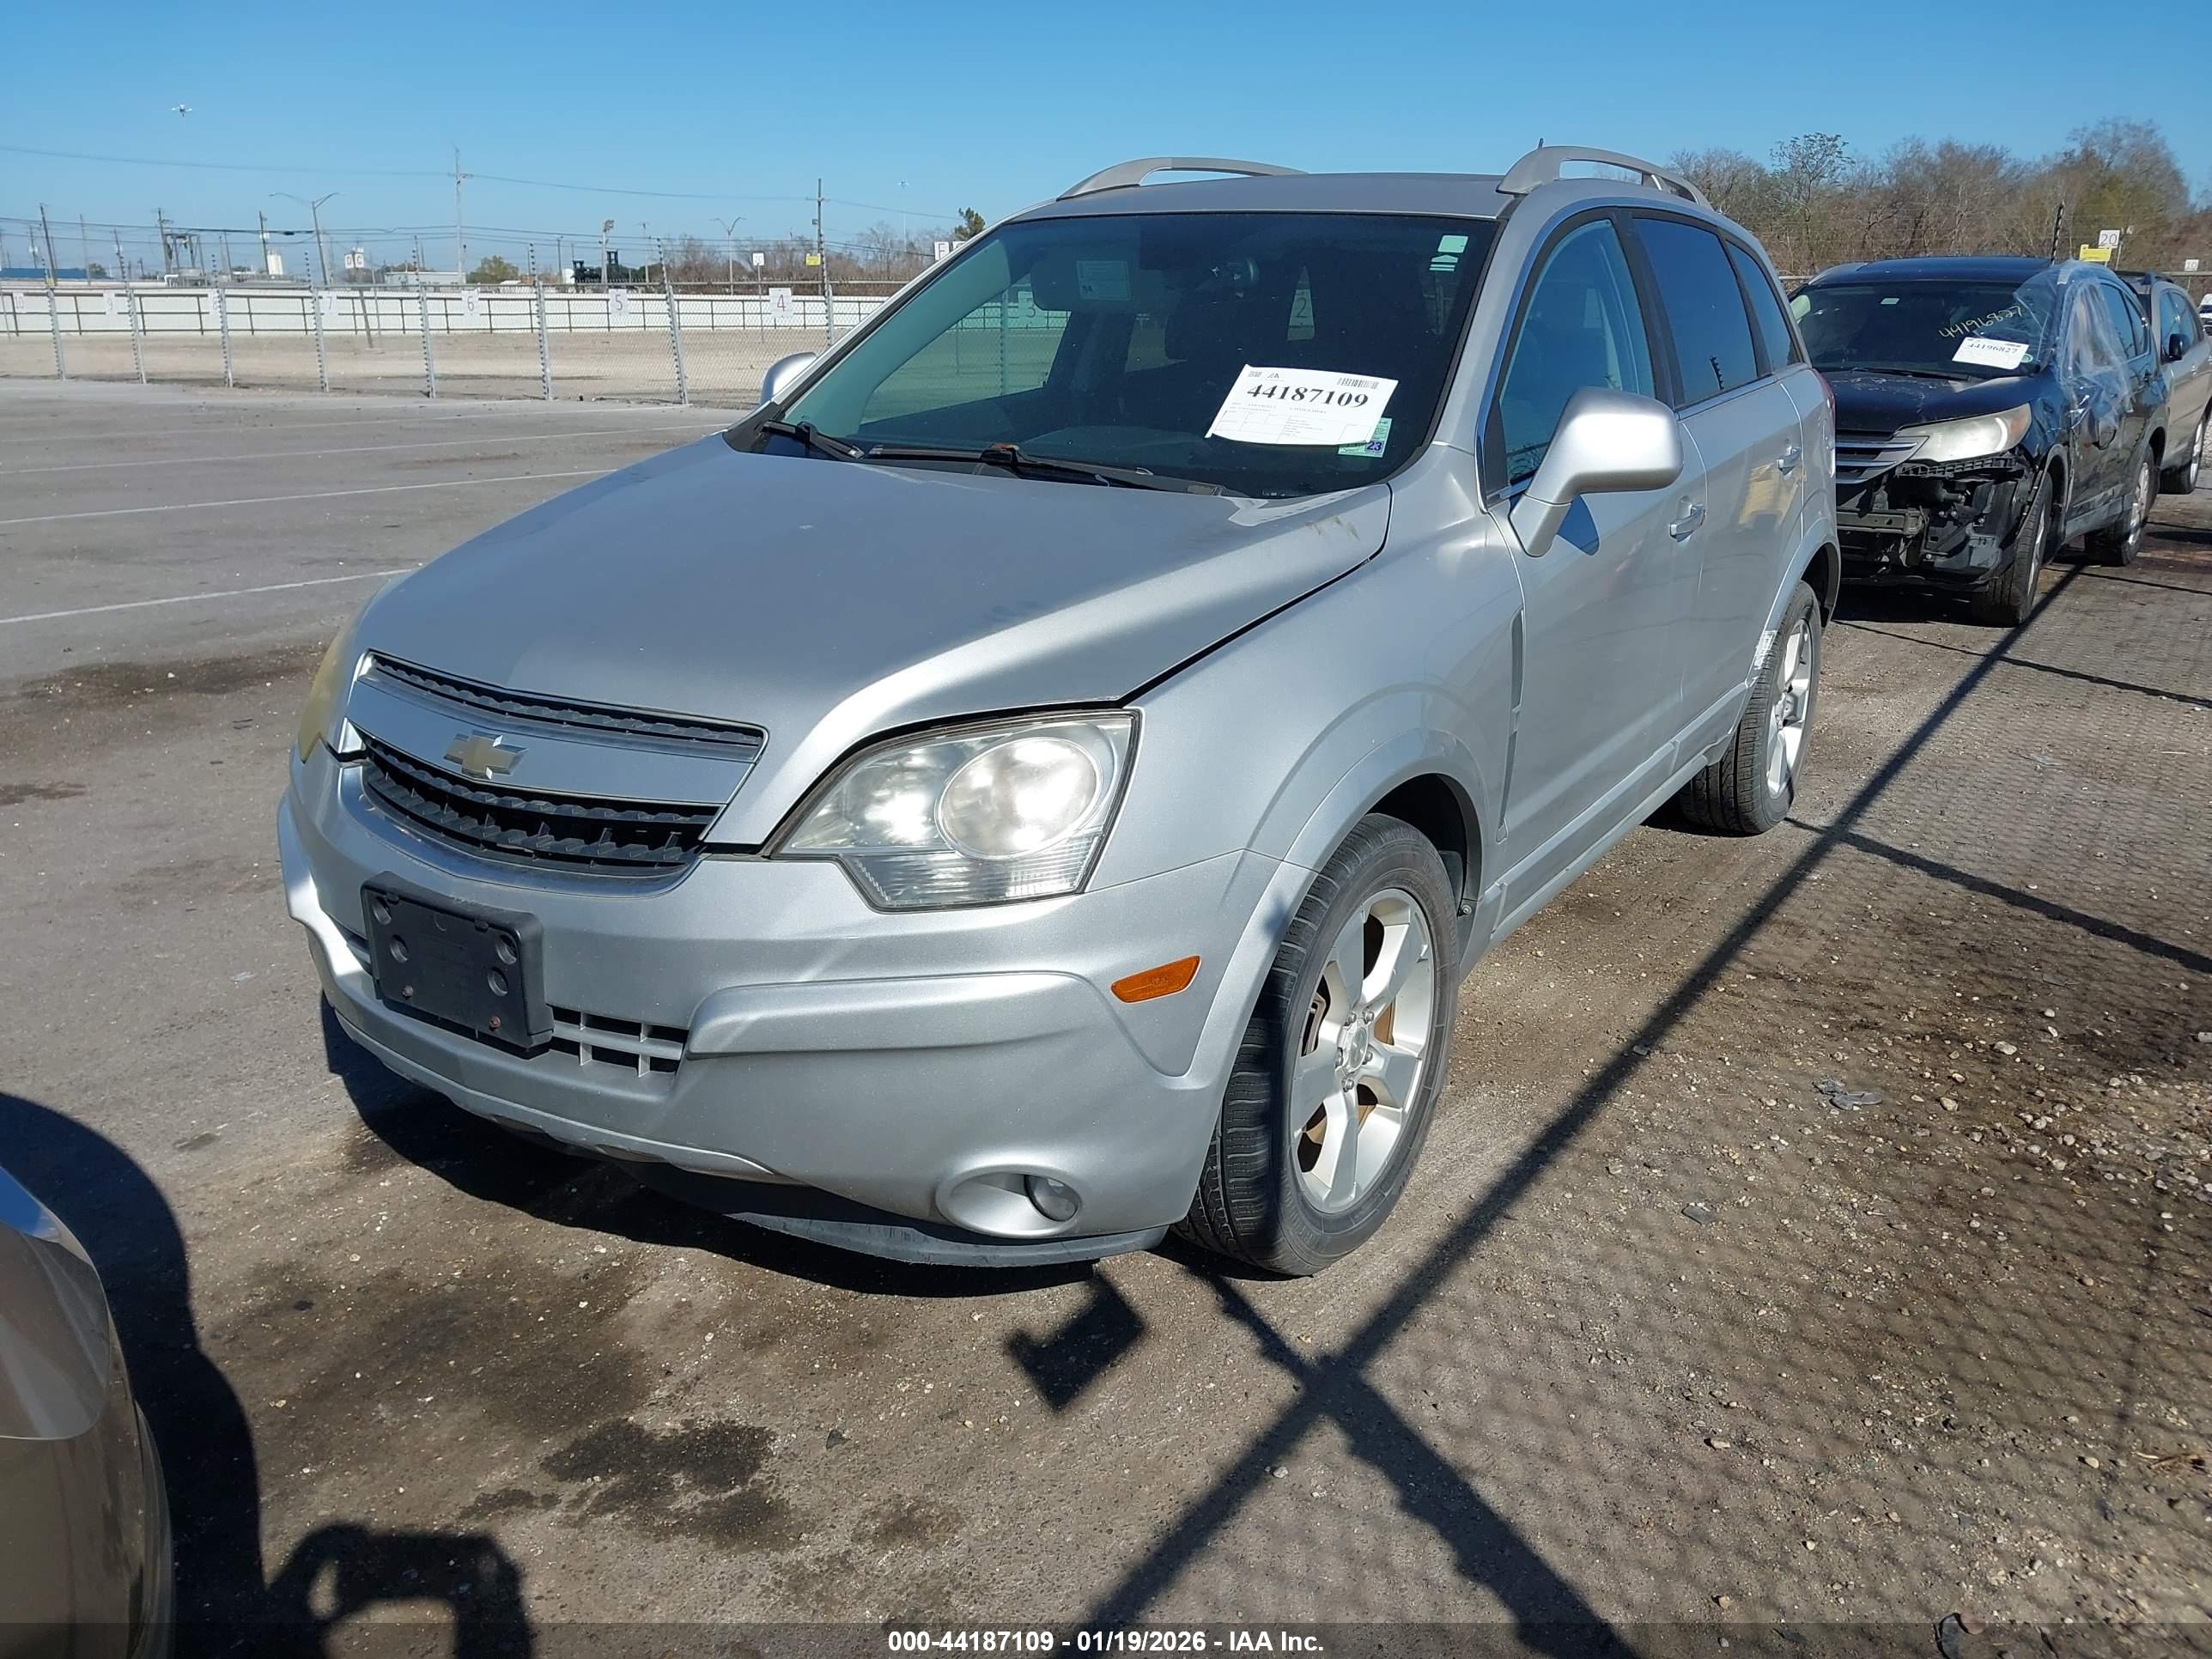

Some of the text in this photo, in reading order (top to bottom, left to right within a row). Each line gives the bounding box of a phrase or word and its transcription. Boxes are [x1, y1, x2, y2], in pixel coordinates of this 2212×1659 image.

[2100, 234, 2118, 246] 20
[467, 296, 474, 312] 6
[616, 295, 623, 312] 5
[776, 295, 786, 312] 4
[1295, 297, 1308, 318] 2
[1938, 305, 2023, 337] 44196827
[1967, 343, 2018, 354] 44196827
[1247, 384, 1369, 408] 44187109
[1366, 441, 1382, 452] 23
